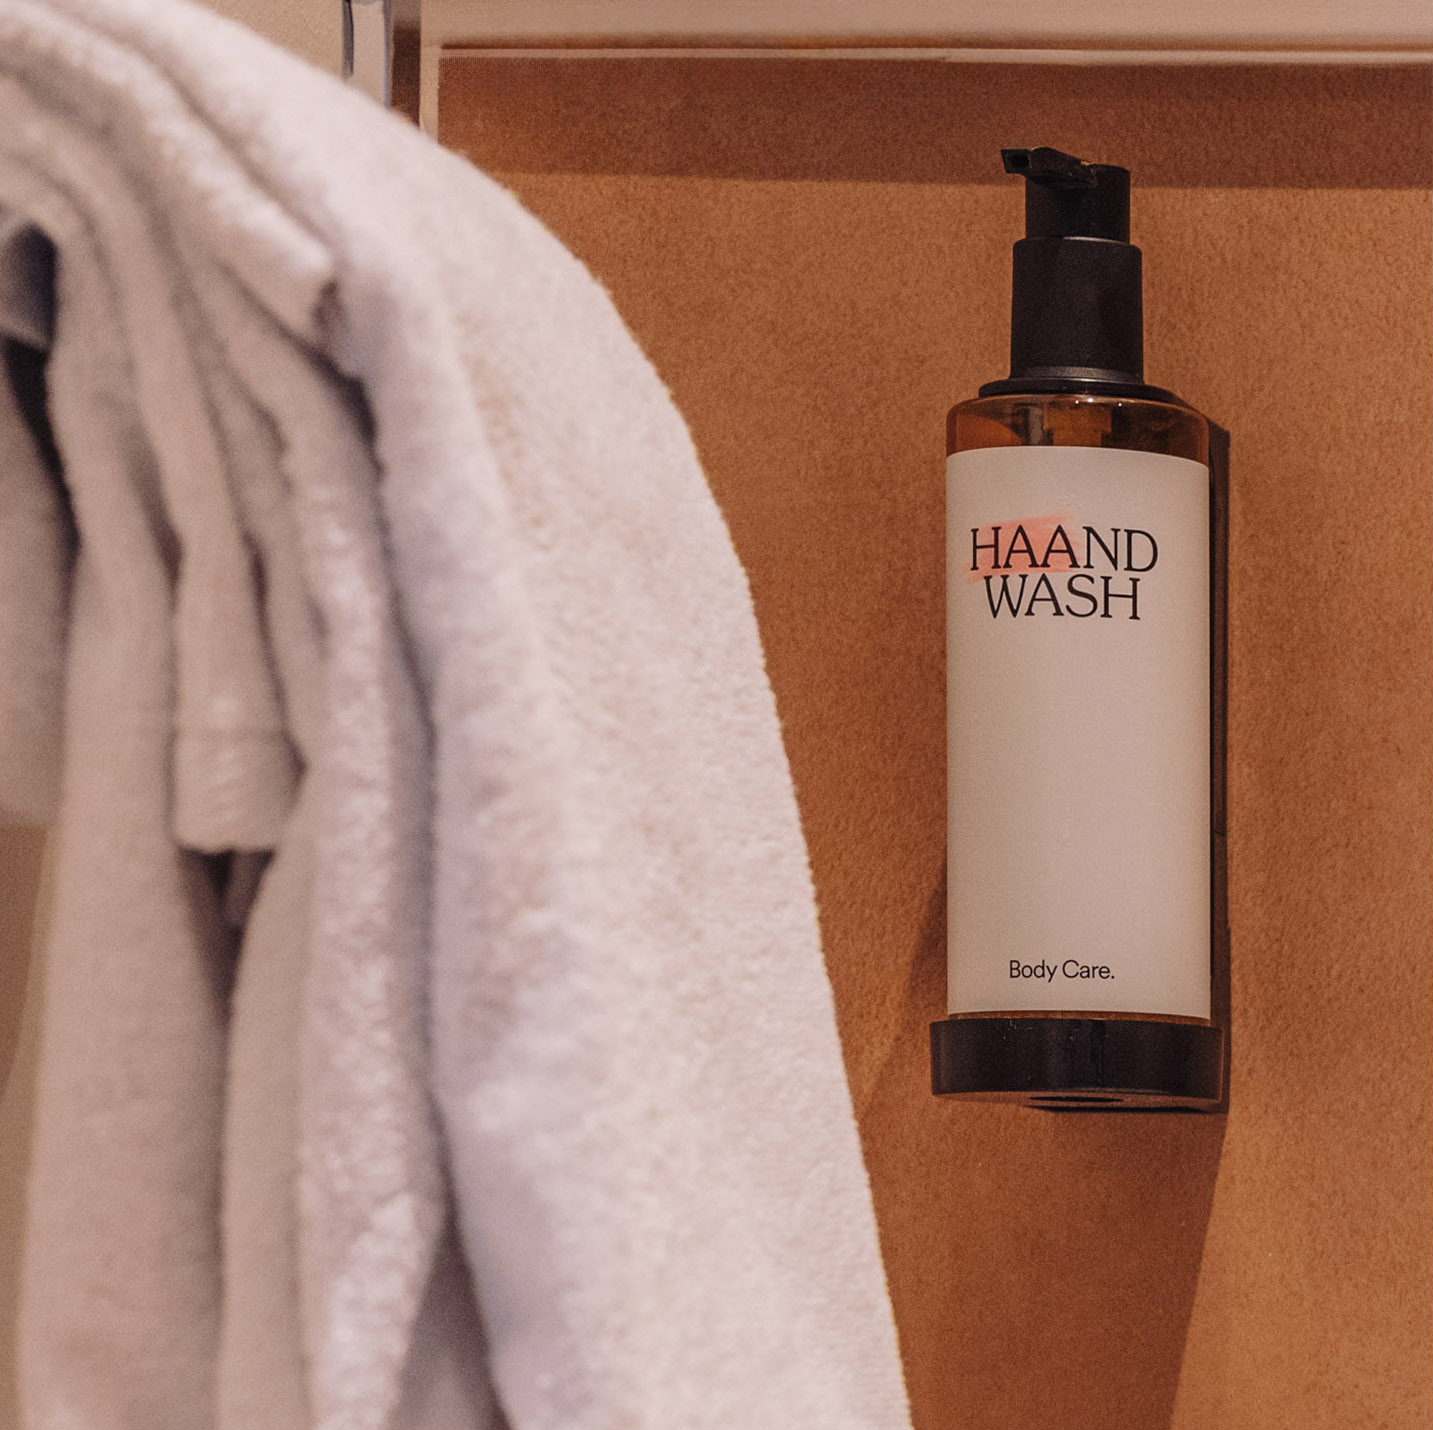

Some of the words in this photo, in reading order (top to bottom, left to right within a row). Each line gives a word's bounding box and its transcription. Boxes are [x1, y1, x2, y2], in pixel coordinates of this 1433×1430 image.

[970, 524, 1159, 574] HAAND
[983, 572, 1143, 621] WASH
[1009, 959, 1058, 983] Body
[1062, 959, 1115, 980] Care.
